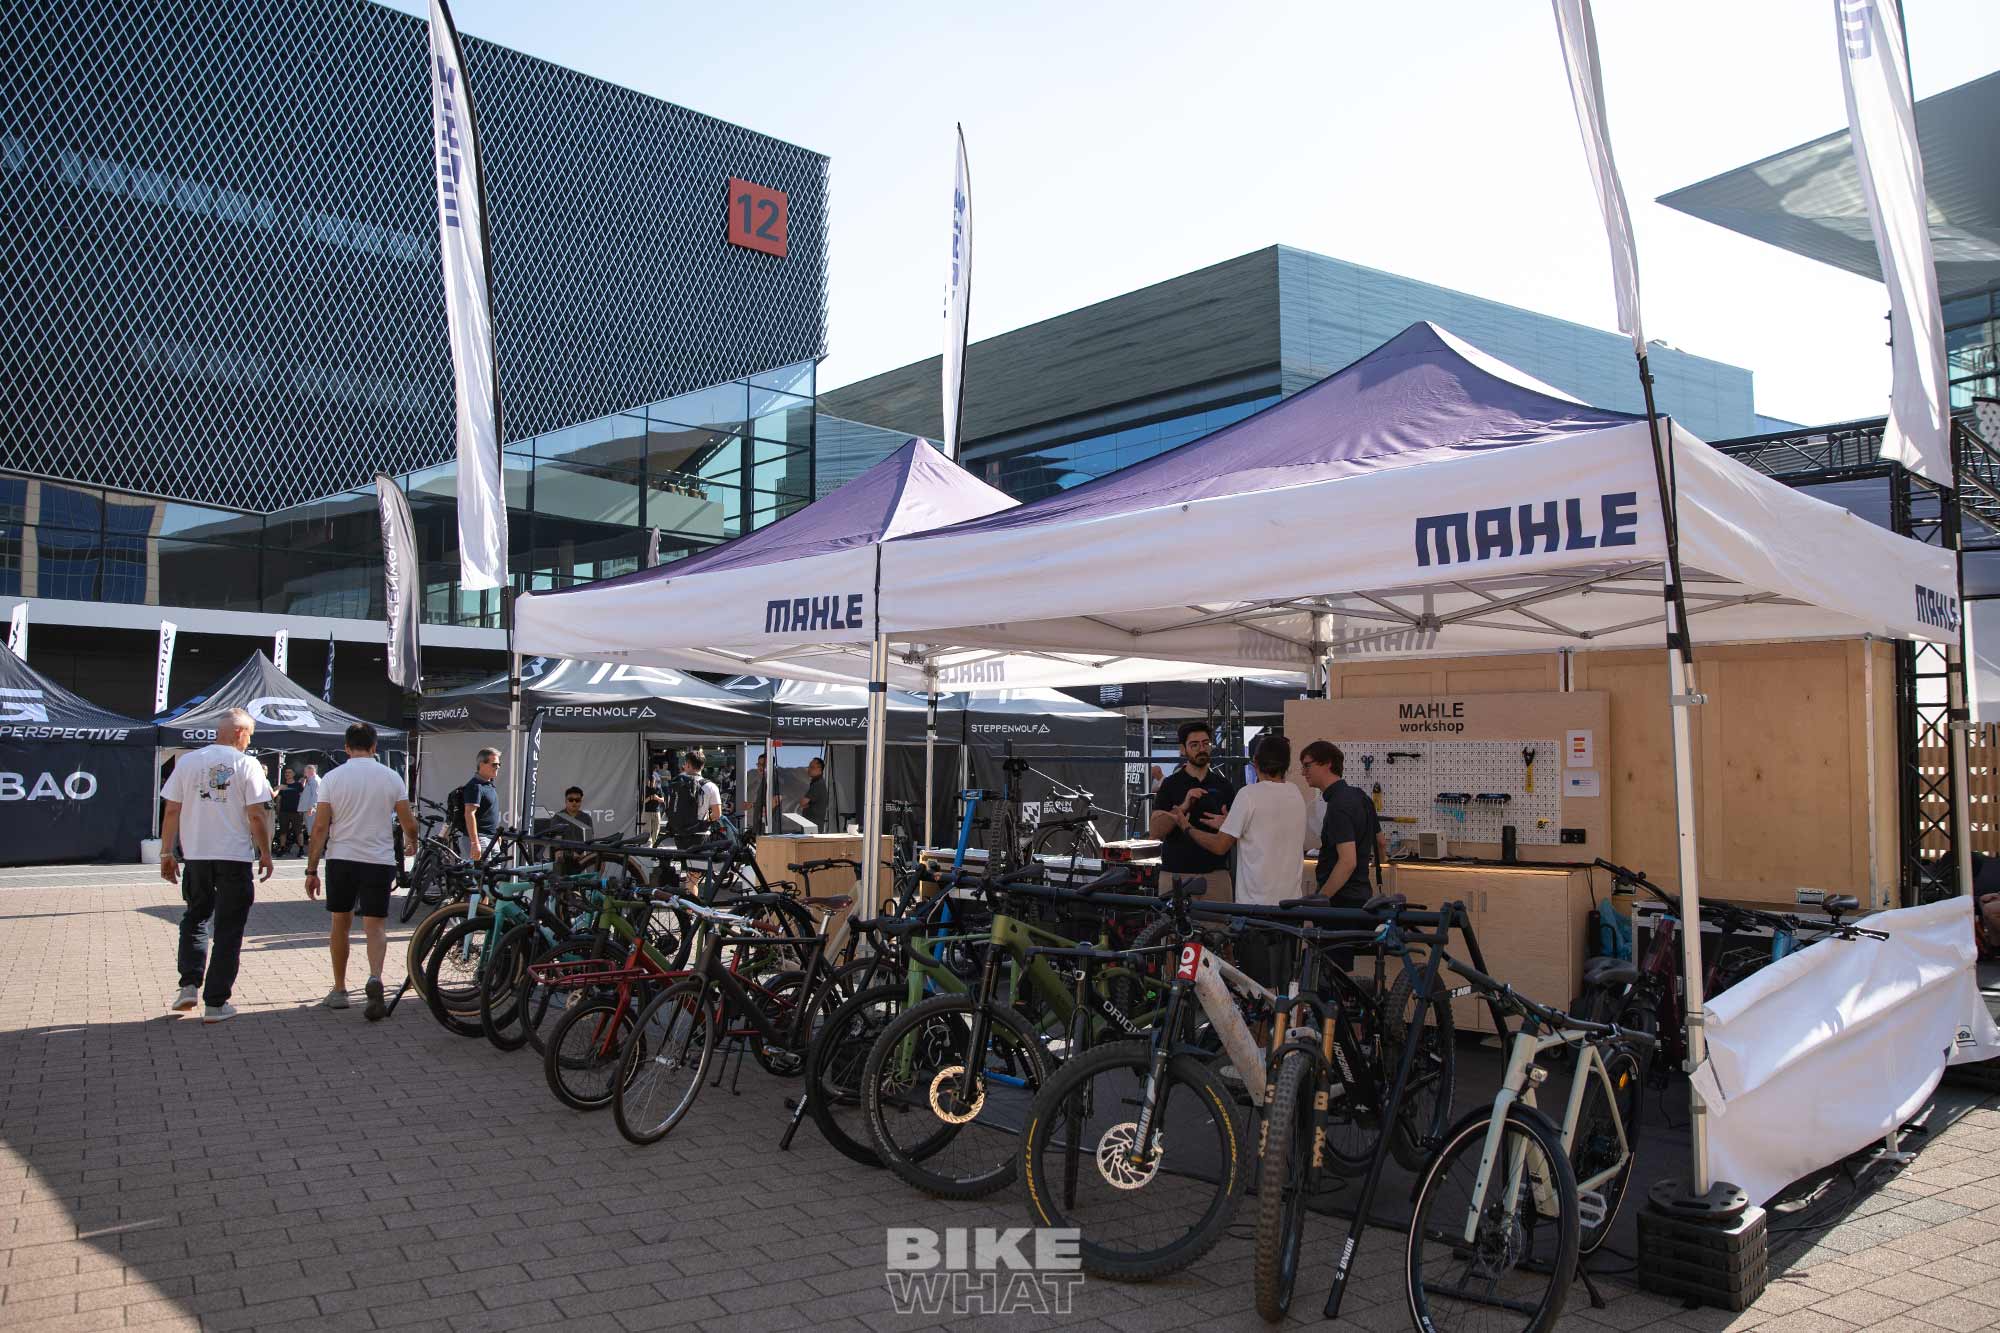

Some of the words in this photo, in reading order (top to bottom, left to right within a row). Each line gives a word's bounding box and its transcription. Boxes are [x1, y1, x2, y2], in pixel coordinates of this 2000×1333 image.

[737, 193, 779, 242] 12
[1415, 491, 1638, 567] MAHLE
[764, 593, 863, 633] MAHLE
[1915, 584, 1957, 632] MAHLE
[420, 708, 461, 721] STEPPENWOLF
[1399, 702, 1465, 719] MAHLE
[777, 716, 857, 727] STEPPENWOLF
[971, 723, 1038, 734] STEPPENWOLF
[1399, 719, 1465, 735] workshop
[0, 725, 130, 741] PERSPECTIVE
[182, 729, 217, 740] GOB
[1103, 1000, 1139, 1033] ORIGI
